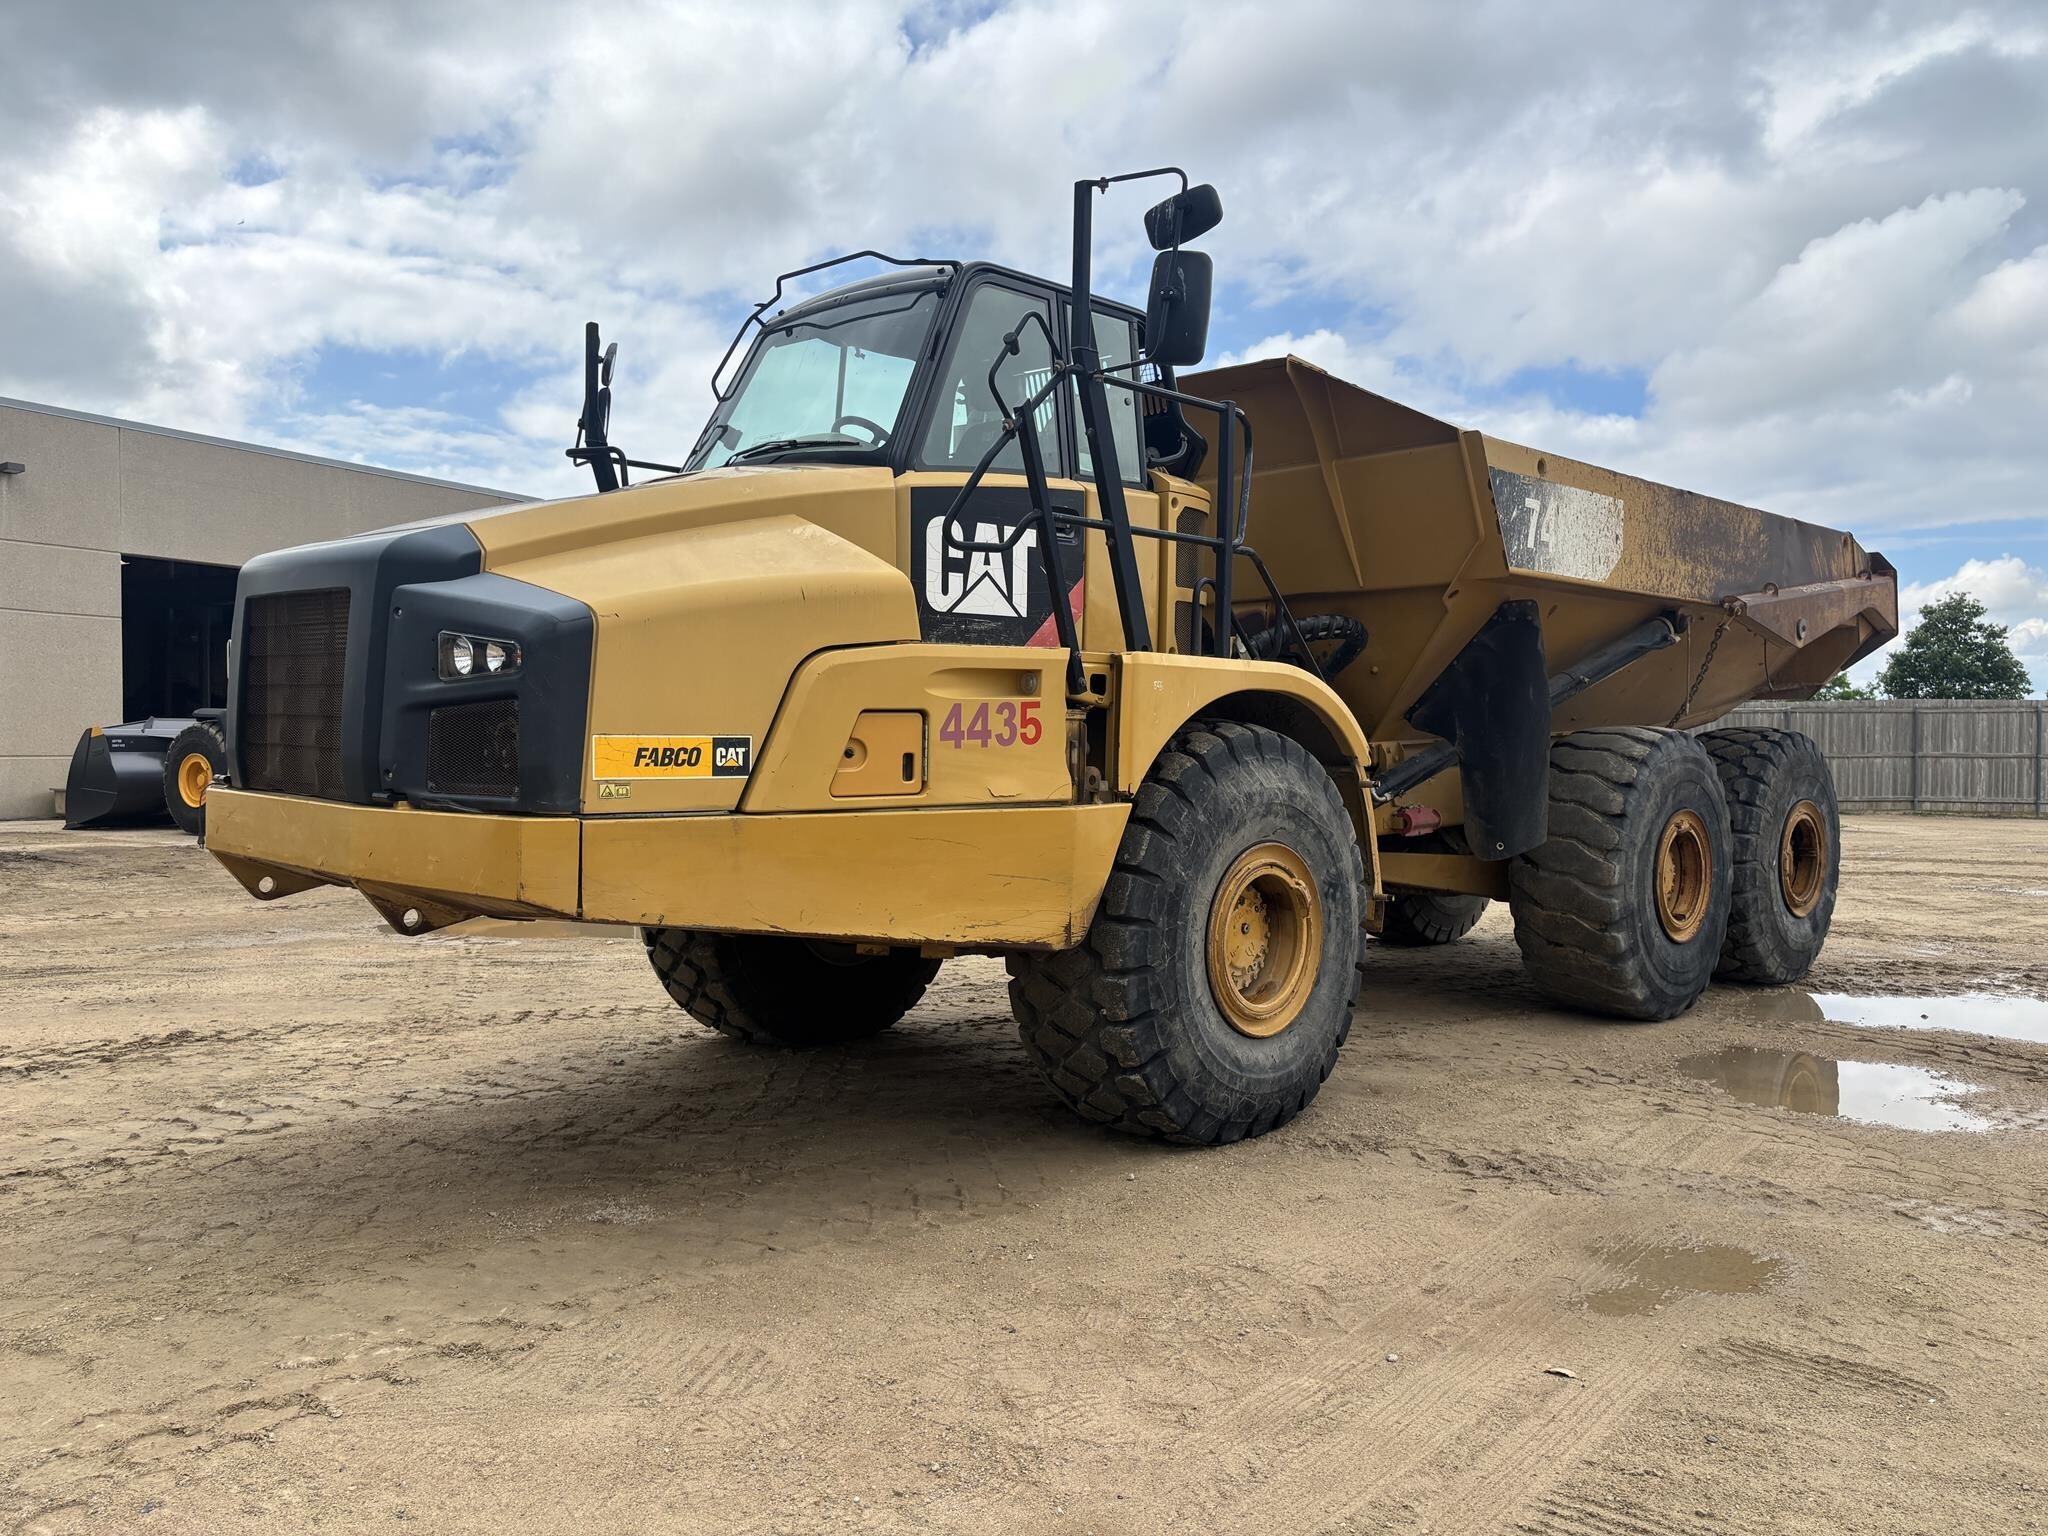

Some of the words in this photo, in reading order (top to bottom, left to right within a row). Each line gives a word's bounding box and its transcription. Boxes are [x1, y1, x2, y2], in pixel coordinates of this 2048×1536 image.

[926, 515, 1037, 618] CAT
[940, 701, 1042, 749] 4435
[633, 747, 702, 767] FABCO
[715, 747, 746, 767] CAT
